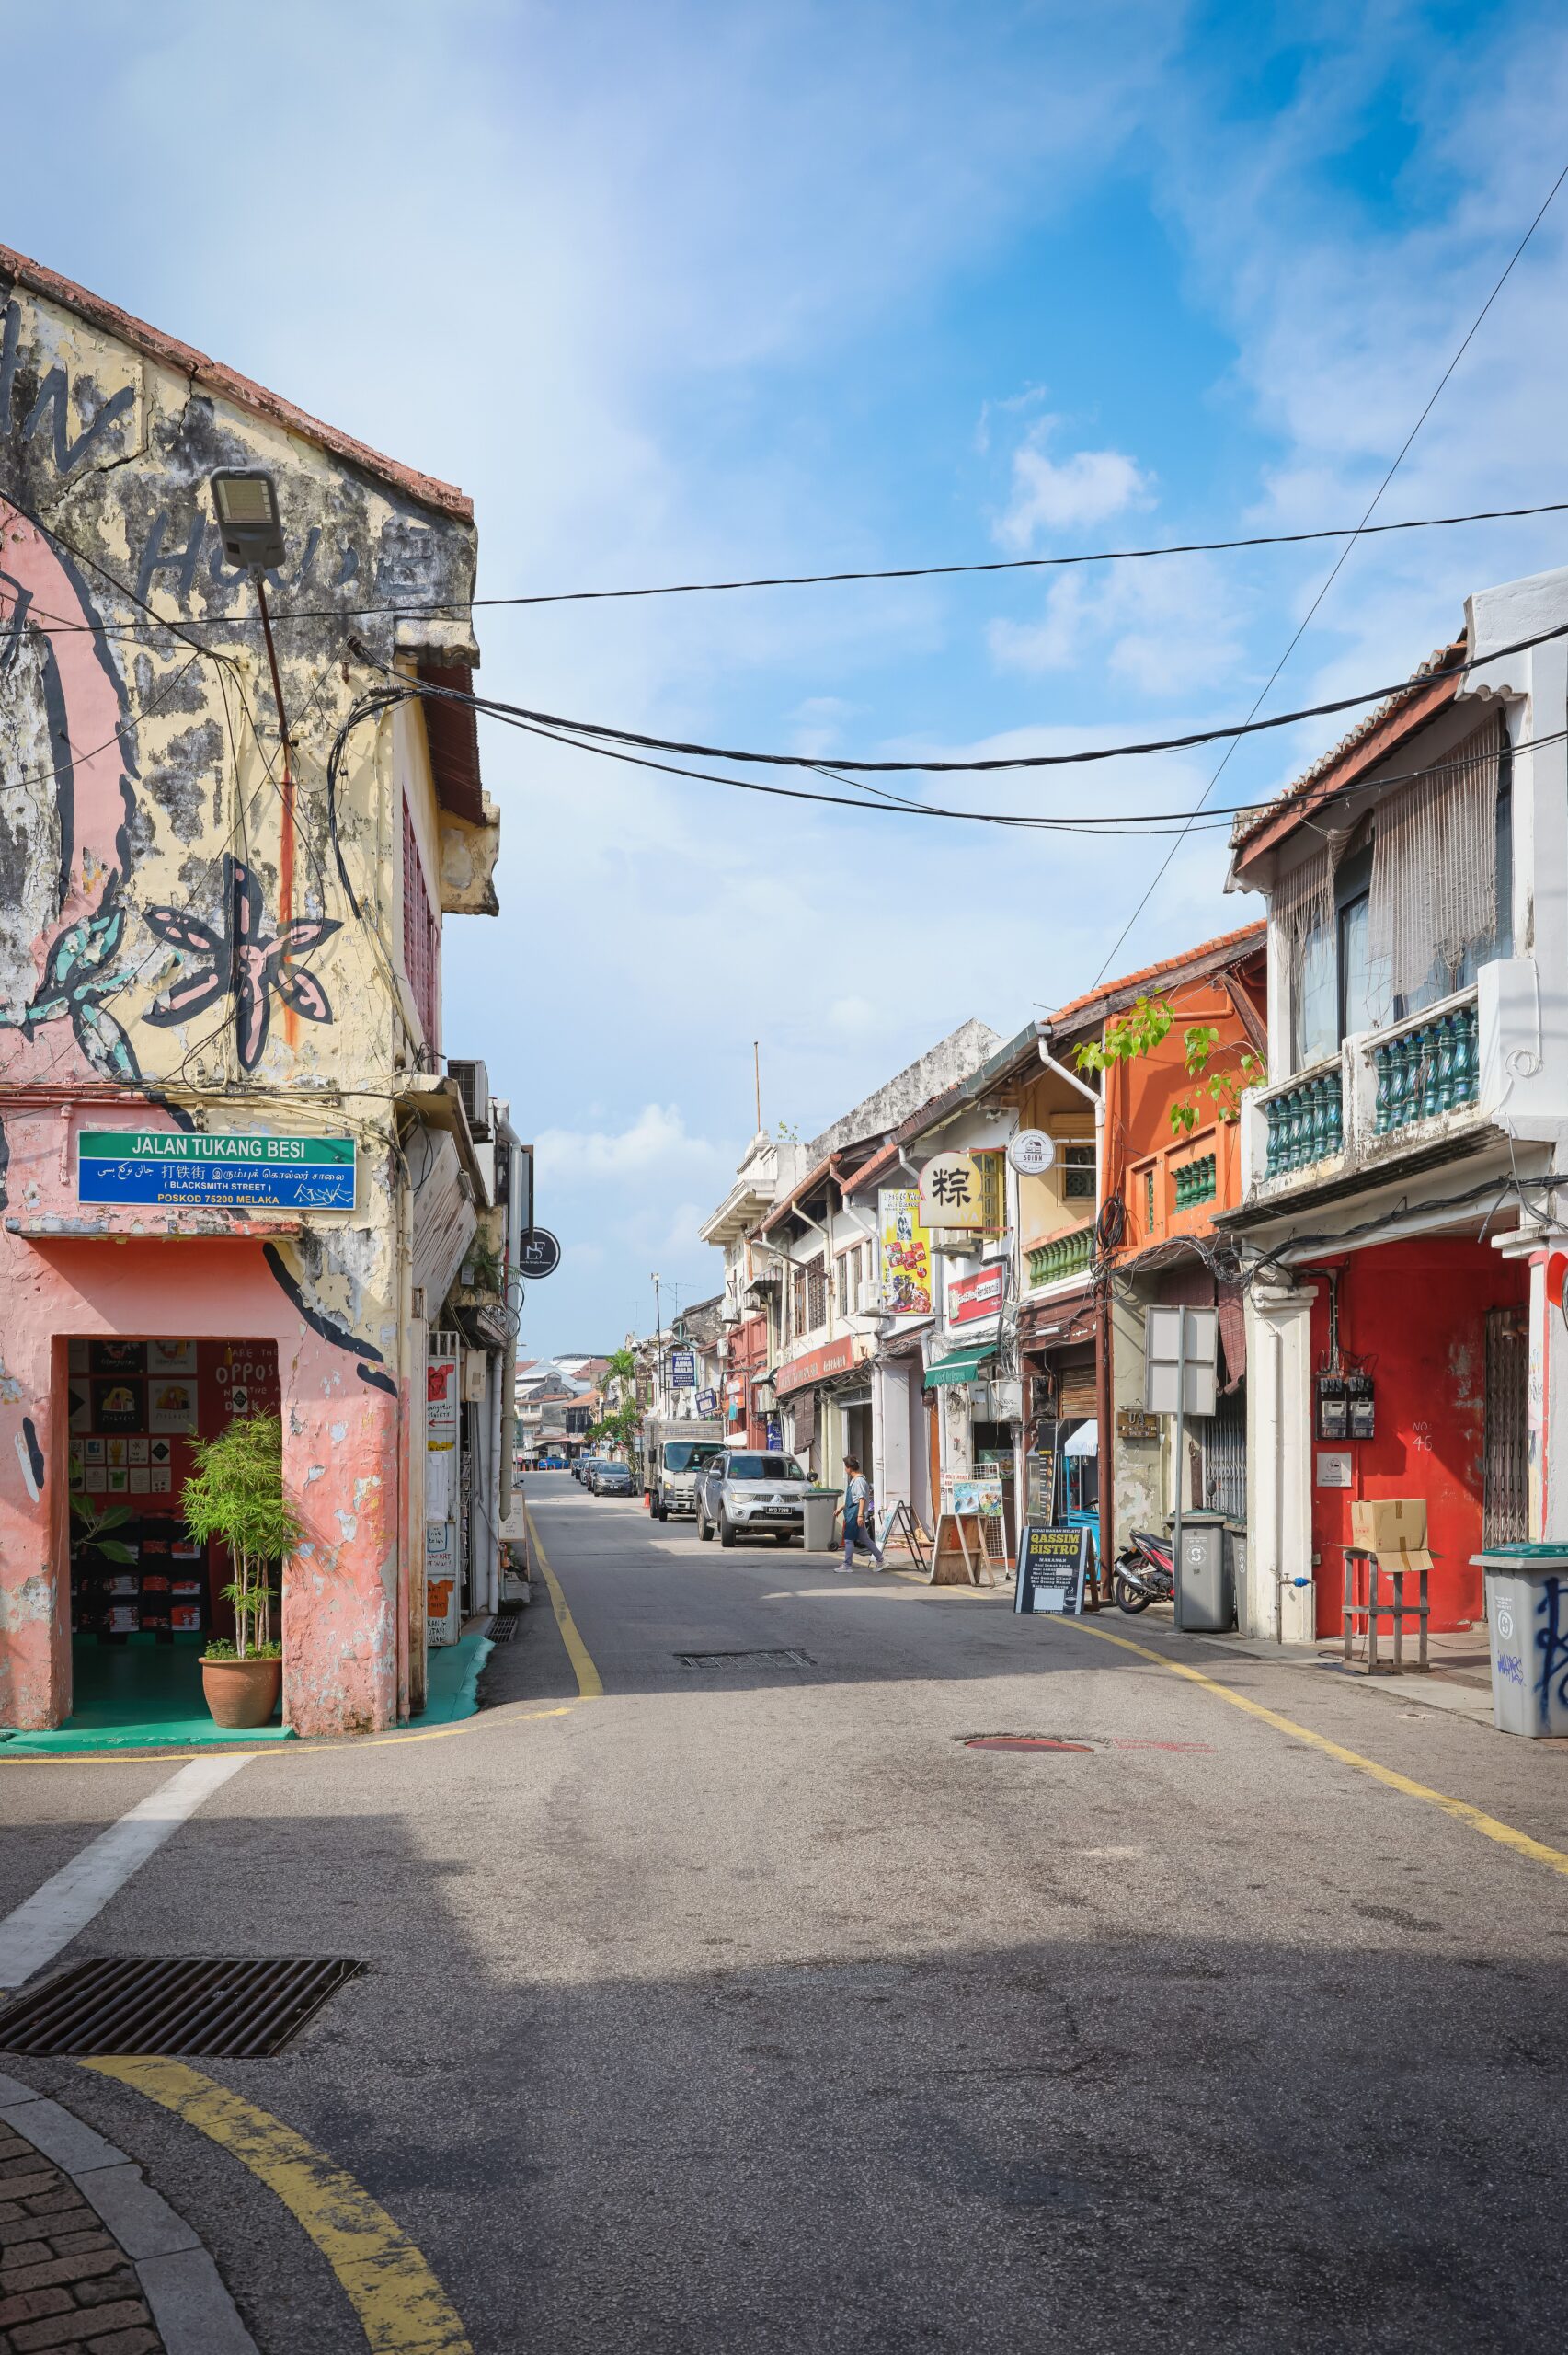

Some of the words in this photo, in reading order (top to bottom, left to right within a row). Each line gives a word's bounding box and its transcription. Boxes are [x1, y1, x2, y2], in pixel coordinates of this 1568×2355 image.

[132, 1137, 188, 1156] JALAN
[192, 1139, 263, 1157] TUKANG
[267, 1141, 305, 1159] BESI
[161, 1164, 206, 1180] 打铁街
[169, 1180, 230, 1190] BLACKSMITH
[231, 1182, 266, 1192] STREET
[932, 1167, 972, 1208] 粽
[157, 1193, 202, 1203] POSKOD
[204, 1194, 234, 1204] 75200
[235, 1195, 280, 1205] MELAKA
[1413, 1435, 1433, 1452] 46
[1030, 1534, 1080, 1544] QASSIM
[1029, 1544, 1079, 1555] BISTRO
